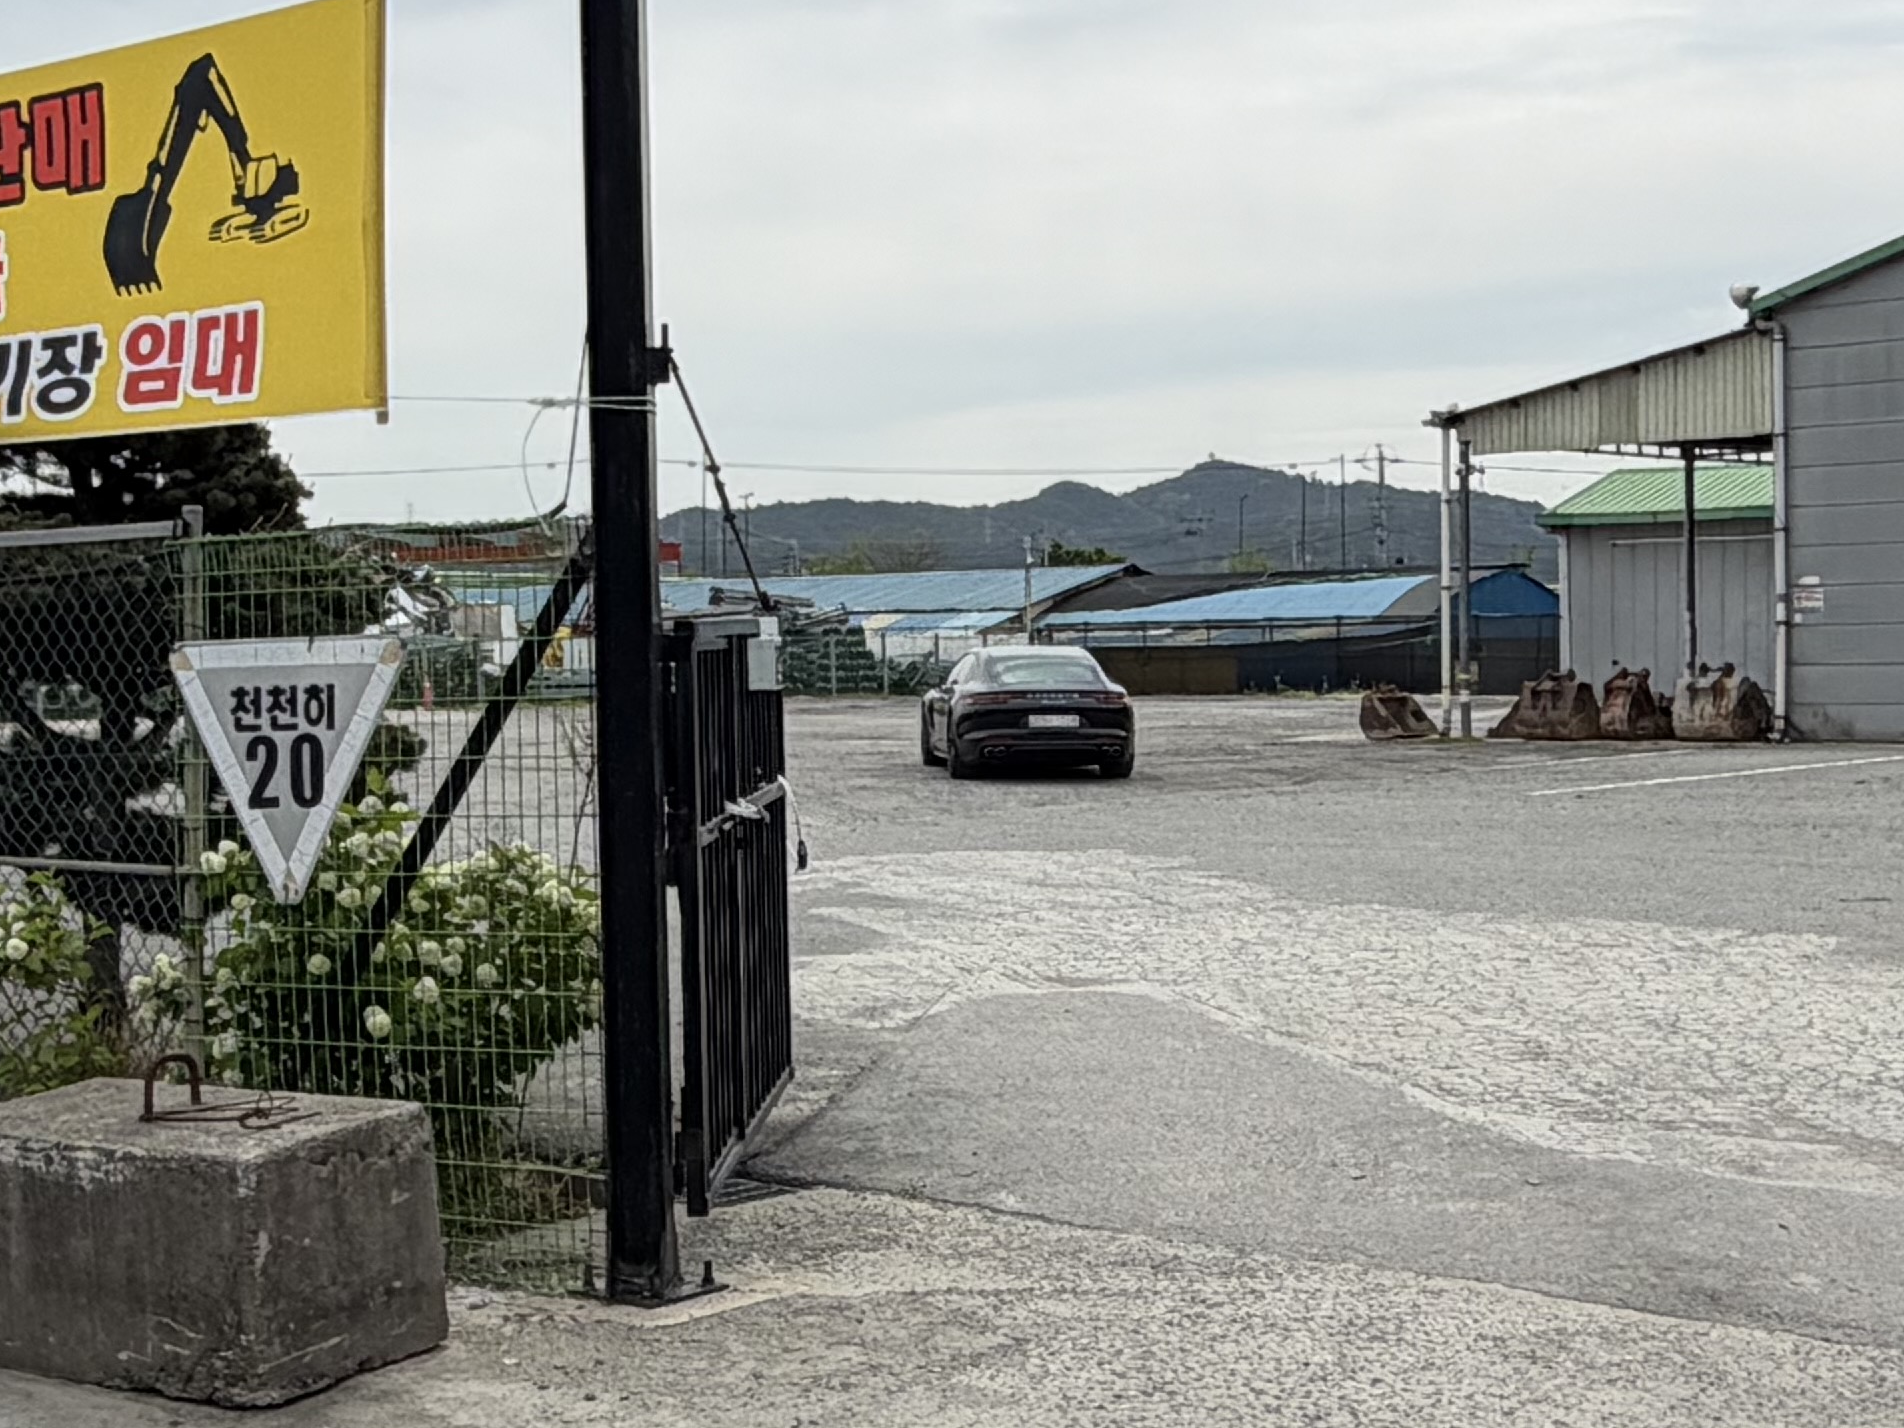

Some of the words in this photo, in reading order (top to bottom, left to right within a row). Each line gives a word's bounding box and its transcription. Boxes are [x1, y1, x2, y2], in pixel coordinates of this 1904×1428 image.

[122, 309, 259, 403] 임대
[230, 683, 336, 733] 천천히
[246, 733, 325, 809] 20
